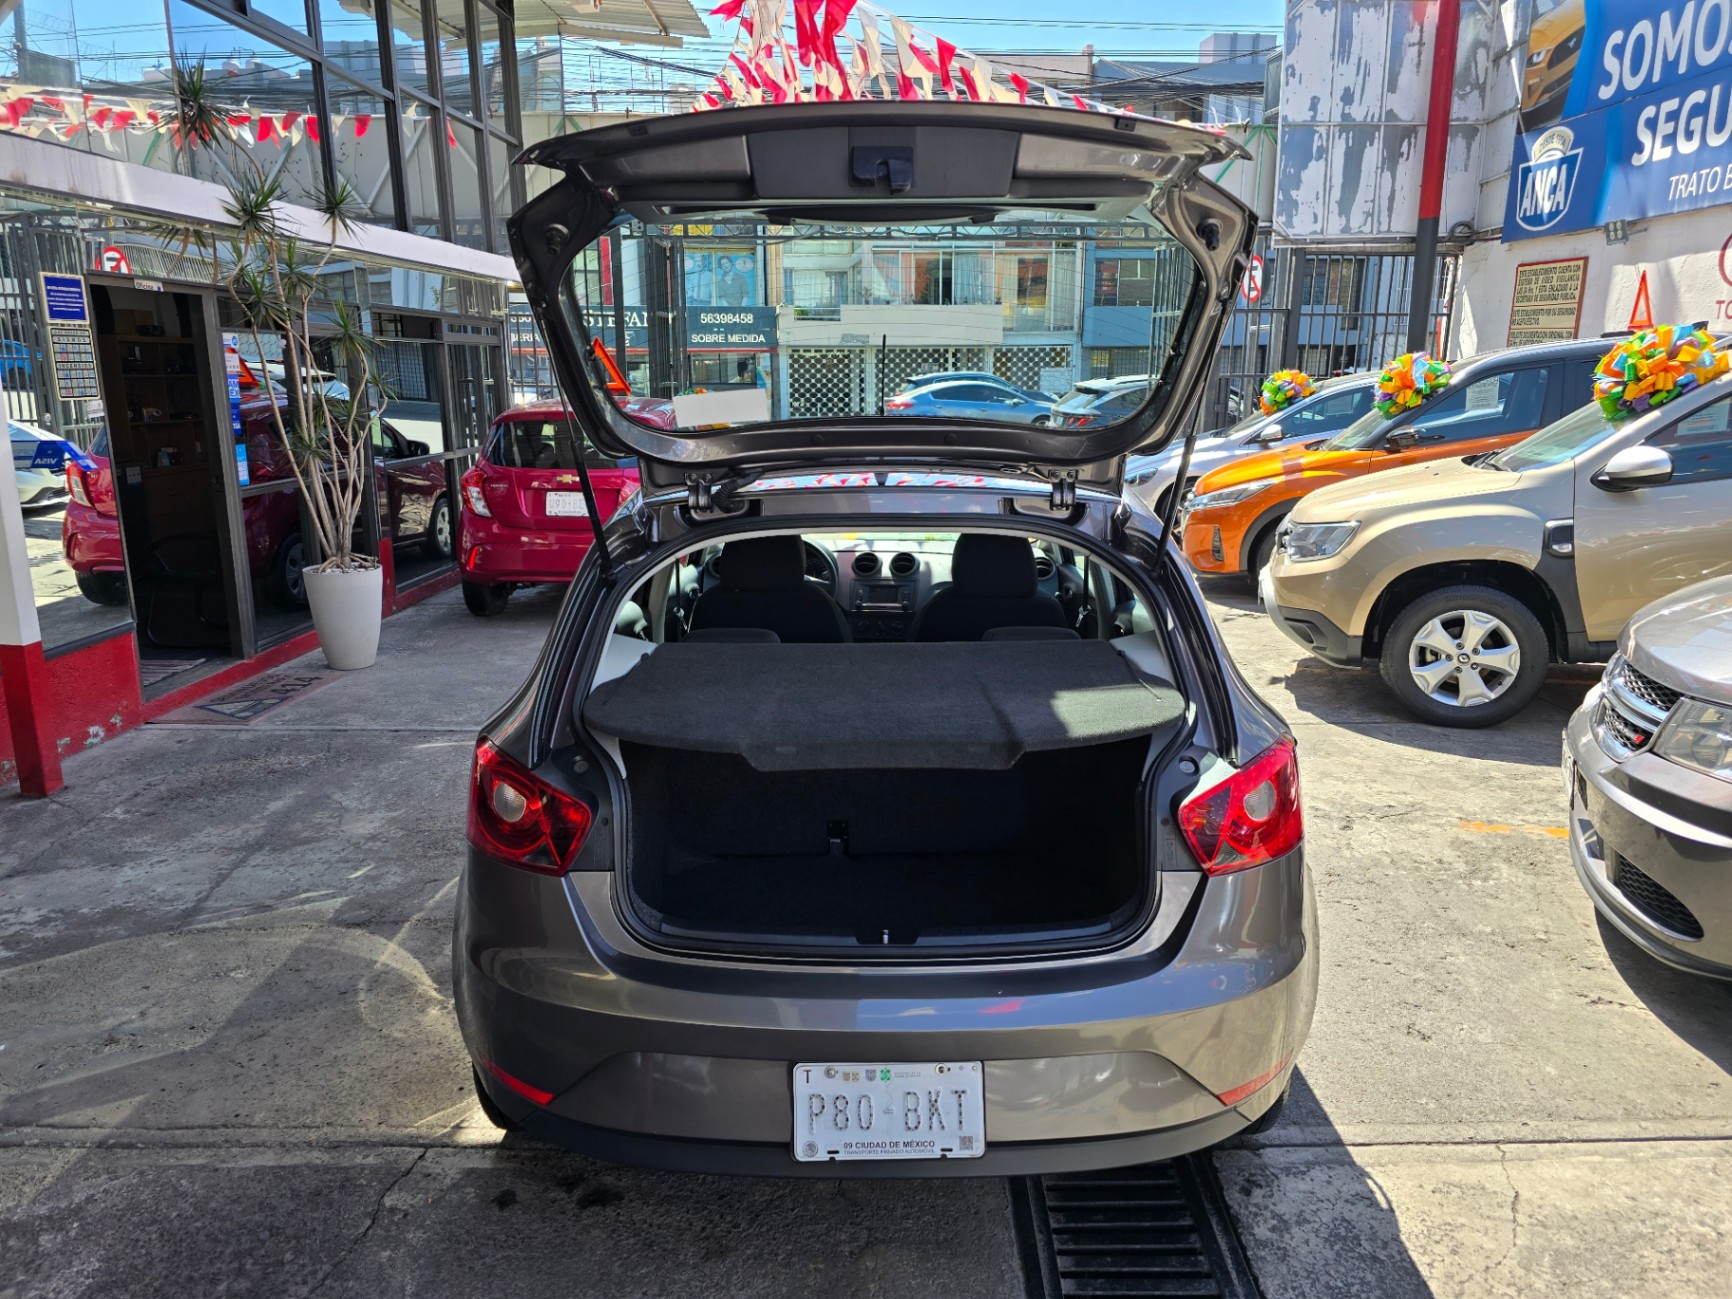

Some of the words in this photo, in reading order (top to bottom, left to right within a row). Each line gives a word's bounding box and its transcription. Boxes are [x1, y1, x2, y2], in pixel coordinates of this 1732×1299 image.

[1598, 0, 1732, 100] SOMO
[1520, 164, 1567, 218] ANCA
[1669, 166, 1722, 201] TRATO
[700, 313, 754, 324] 56398458
[691, 334, 726, 343] SOBRE
[728, 334, 766, 343] MEDIDA
[843, 1142, 853, 1150] 09
[855, 1141, 887, 1150] CIUDAD
[889, 1141, 901, 1149] DE
[902, 1139, 935, 1149] MÉXICO
